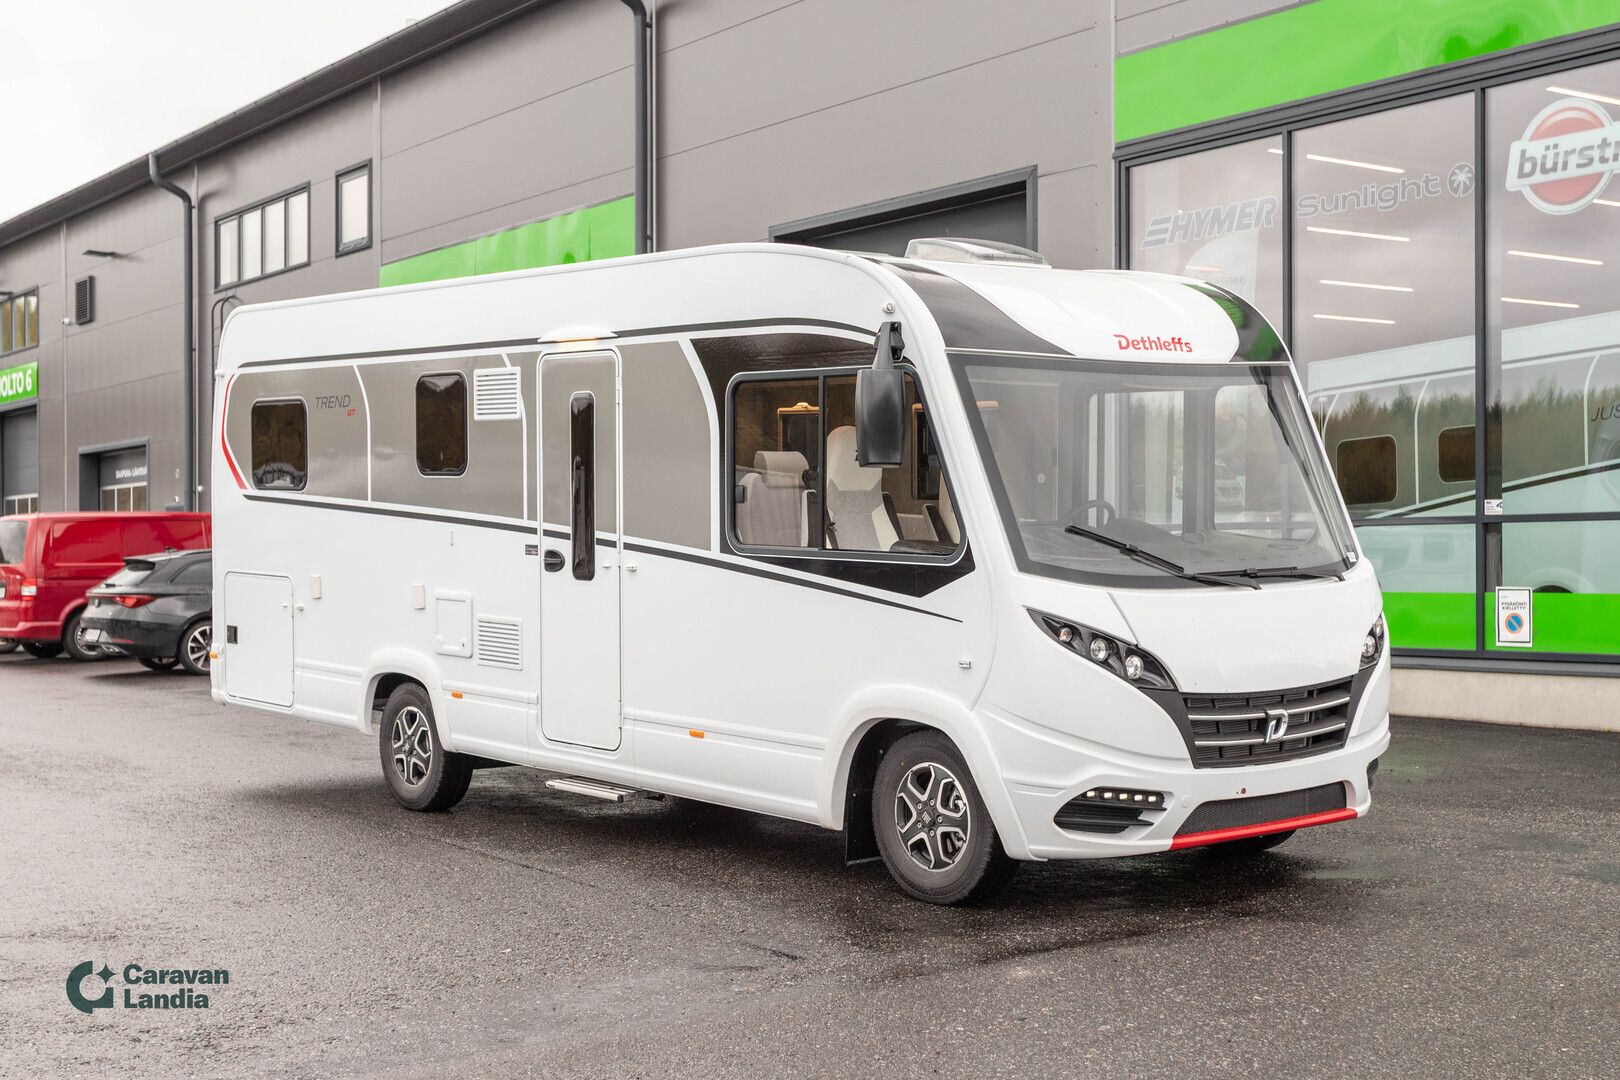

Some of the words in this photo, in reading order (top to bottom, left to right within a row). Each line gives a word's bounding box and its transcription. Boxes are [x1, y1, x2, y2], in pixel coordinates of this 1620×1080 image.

[1296, 174, 1441, 218] Sunlight
[1168, 196, 1279, 244] HYMER
[1113, 334, 1193, 353] Dethleffs
[0, 371, 24, 397] OLTO
[25, 368, 33, 391] 6
[315, 395, 351, 409] TREND
[347, 408, 356, 416] GT
